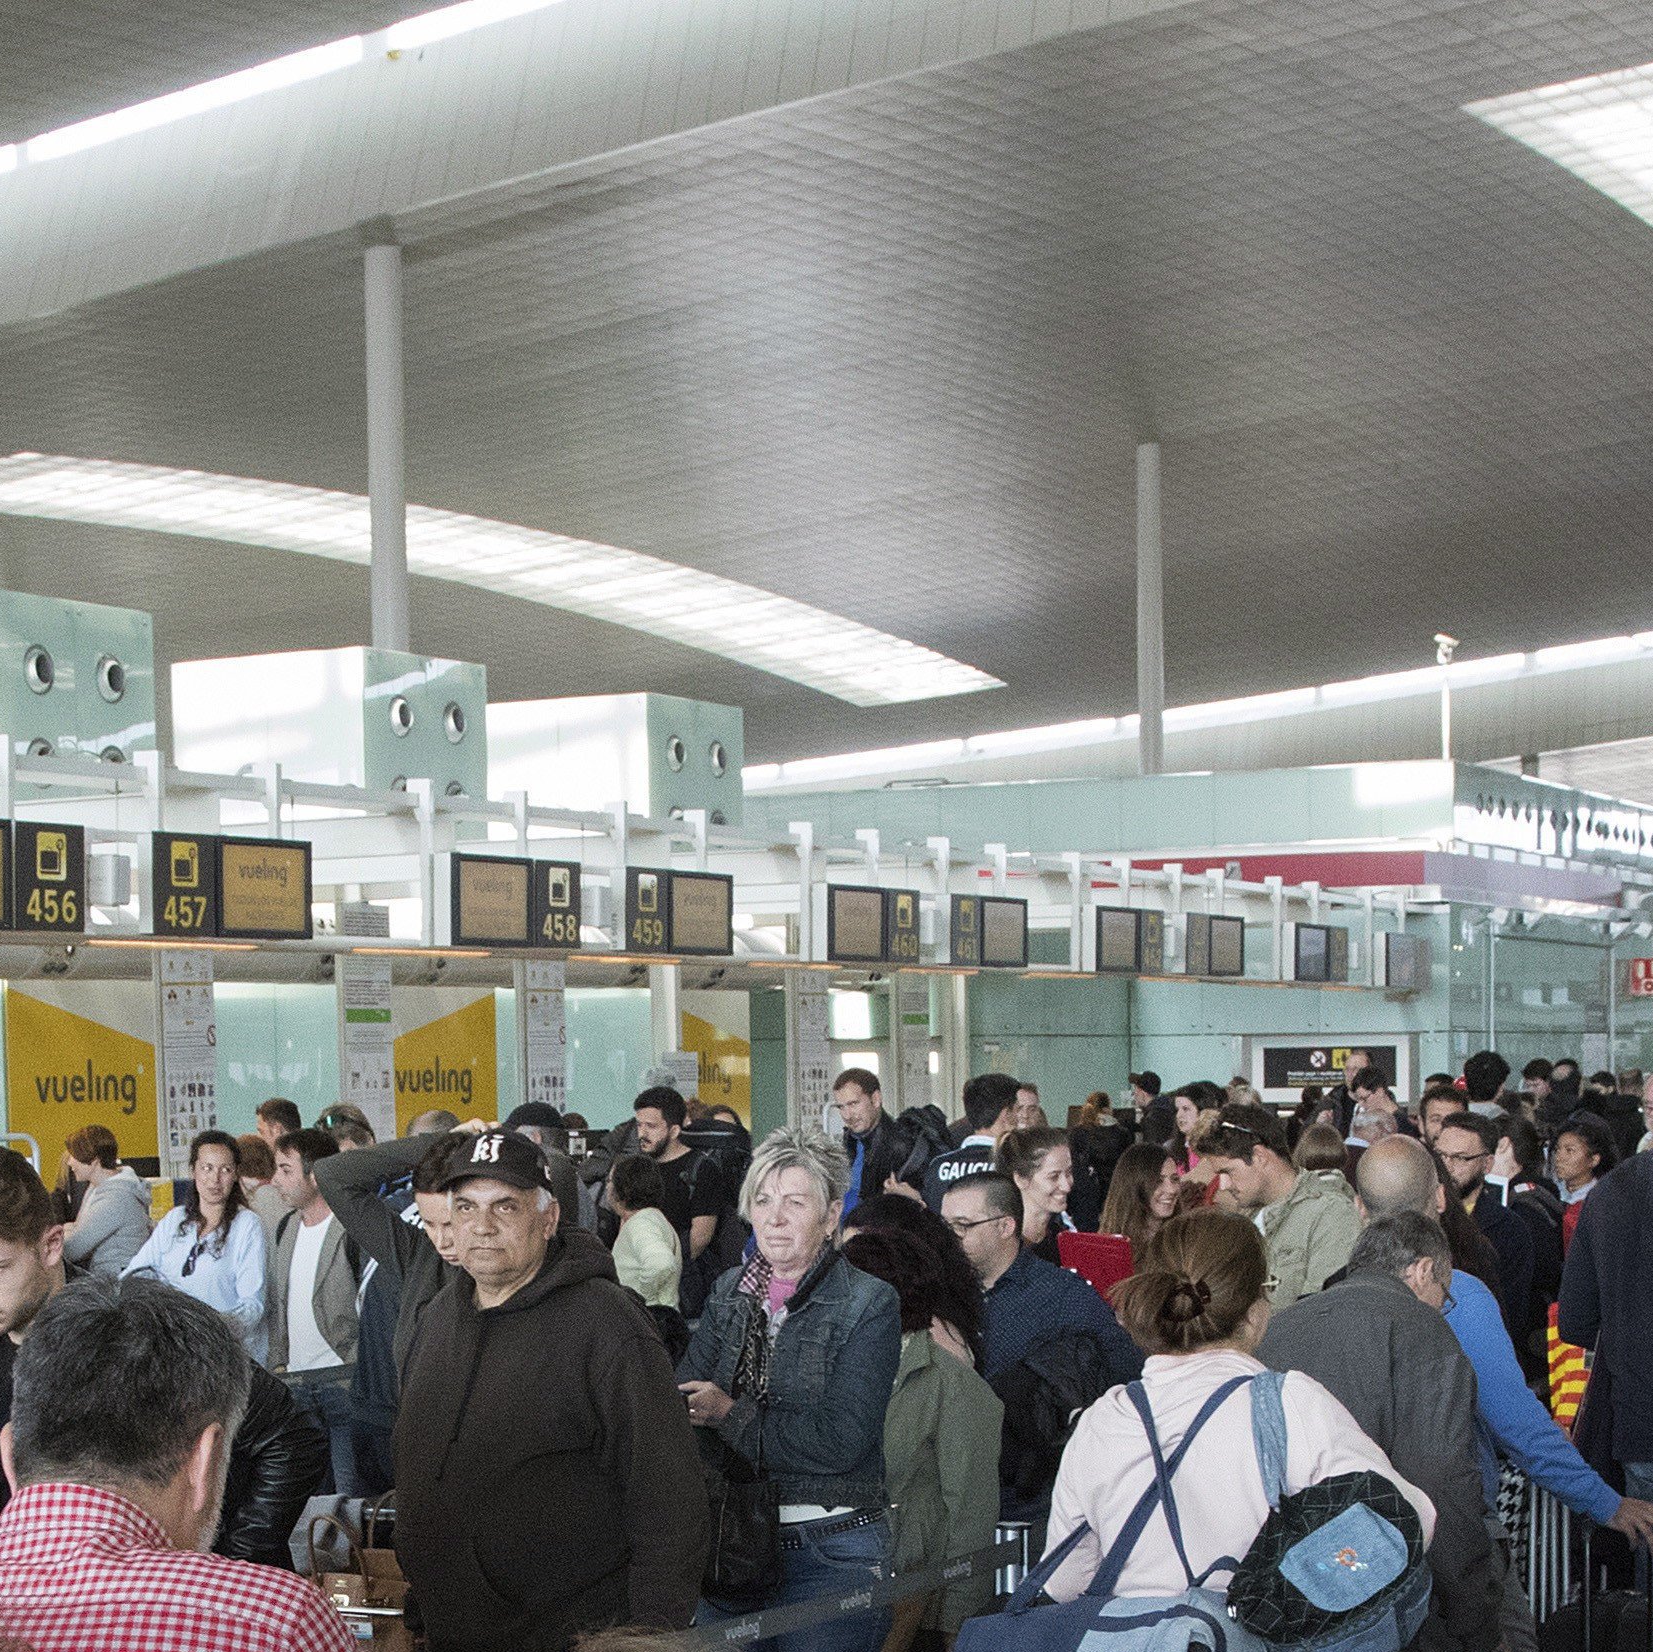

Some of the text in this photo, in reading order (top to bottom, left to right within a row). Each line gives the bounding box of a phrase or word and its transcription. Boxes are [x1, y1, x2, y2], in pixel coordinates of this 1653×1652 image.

[239, 858, 288, 888] vueling
[26, 888, 78, 923] 456
[163, 896, 208, 929] 457
[542, 914, 577, 942] 458
[633, 918, 664, 945] 459
[35, 1058, 137, 1115] vueling
[395, 1055, 473, 1105] vueling
